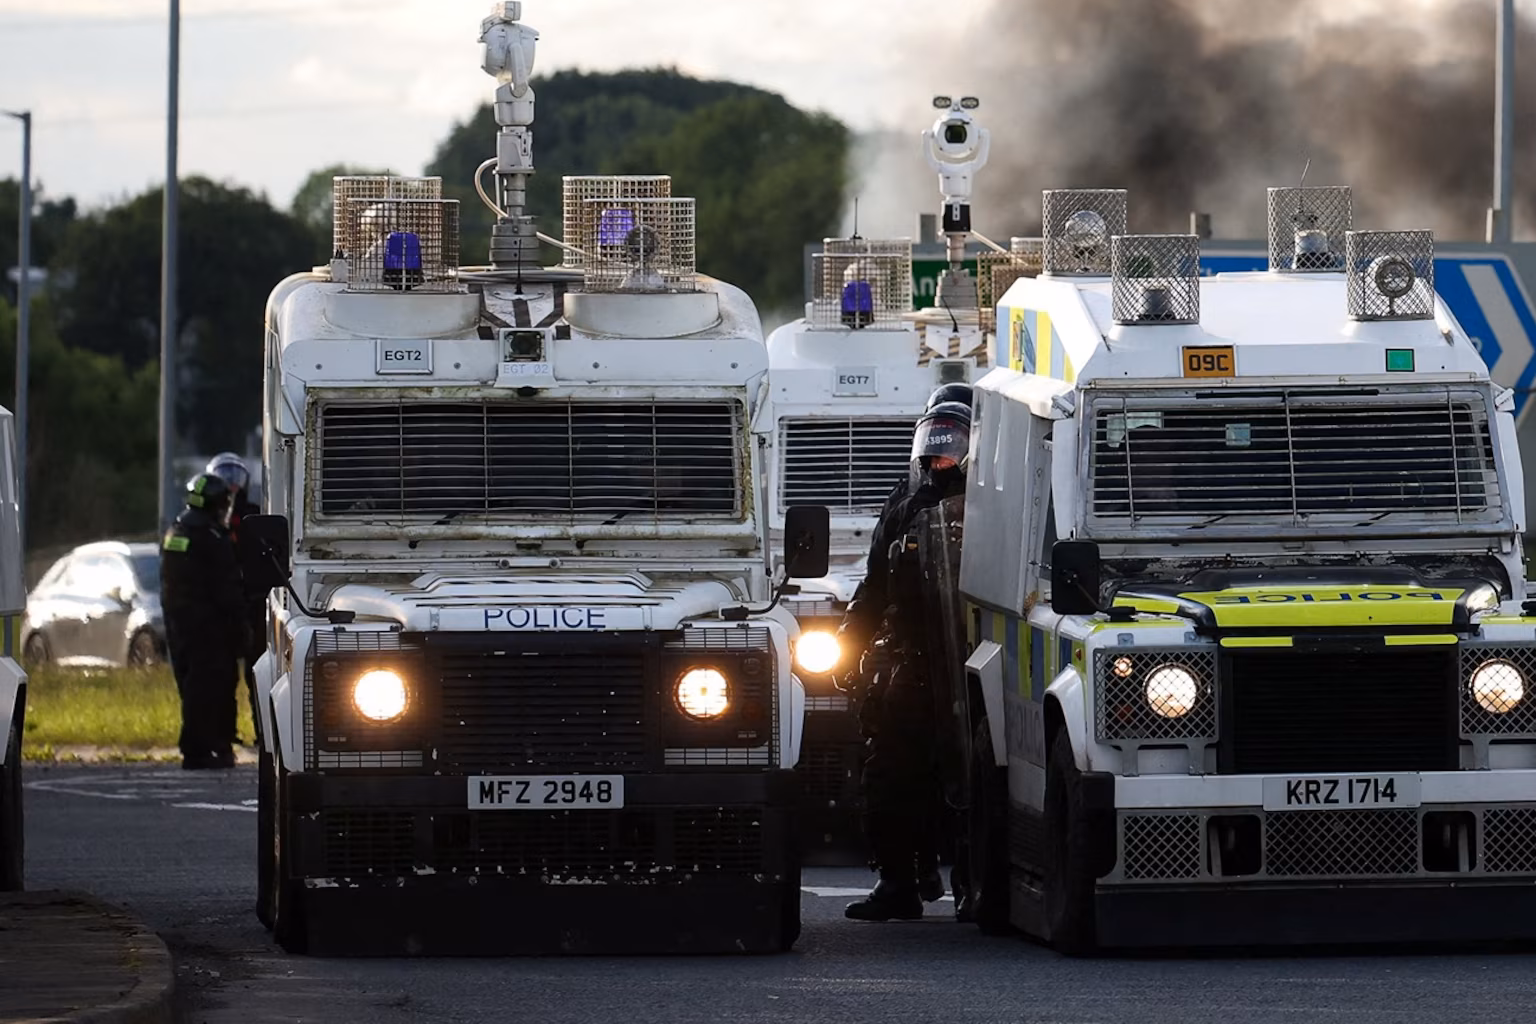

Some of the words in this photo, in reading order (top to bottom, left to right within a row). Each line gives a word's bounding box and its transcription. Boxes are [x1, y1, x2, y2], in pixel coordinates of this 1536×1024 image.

[384, 350, 422, 361] EGT2
[1188, 354, 1229, 372] 09C
[503, 364, 526, 374] EGT
[839, 375, 869, 385] EGT7
[1214, 592, 1444, 605] POLICE
[484, 607, 606, 629] POLICE
[479, 780, 531, 804] MFZ
[543, 780, 612, 804] 2948
[1286, 779, 1340, 805] KRZ
[1348, 778, 1397, 804] 1714
